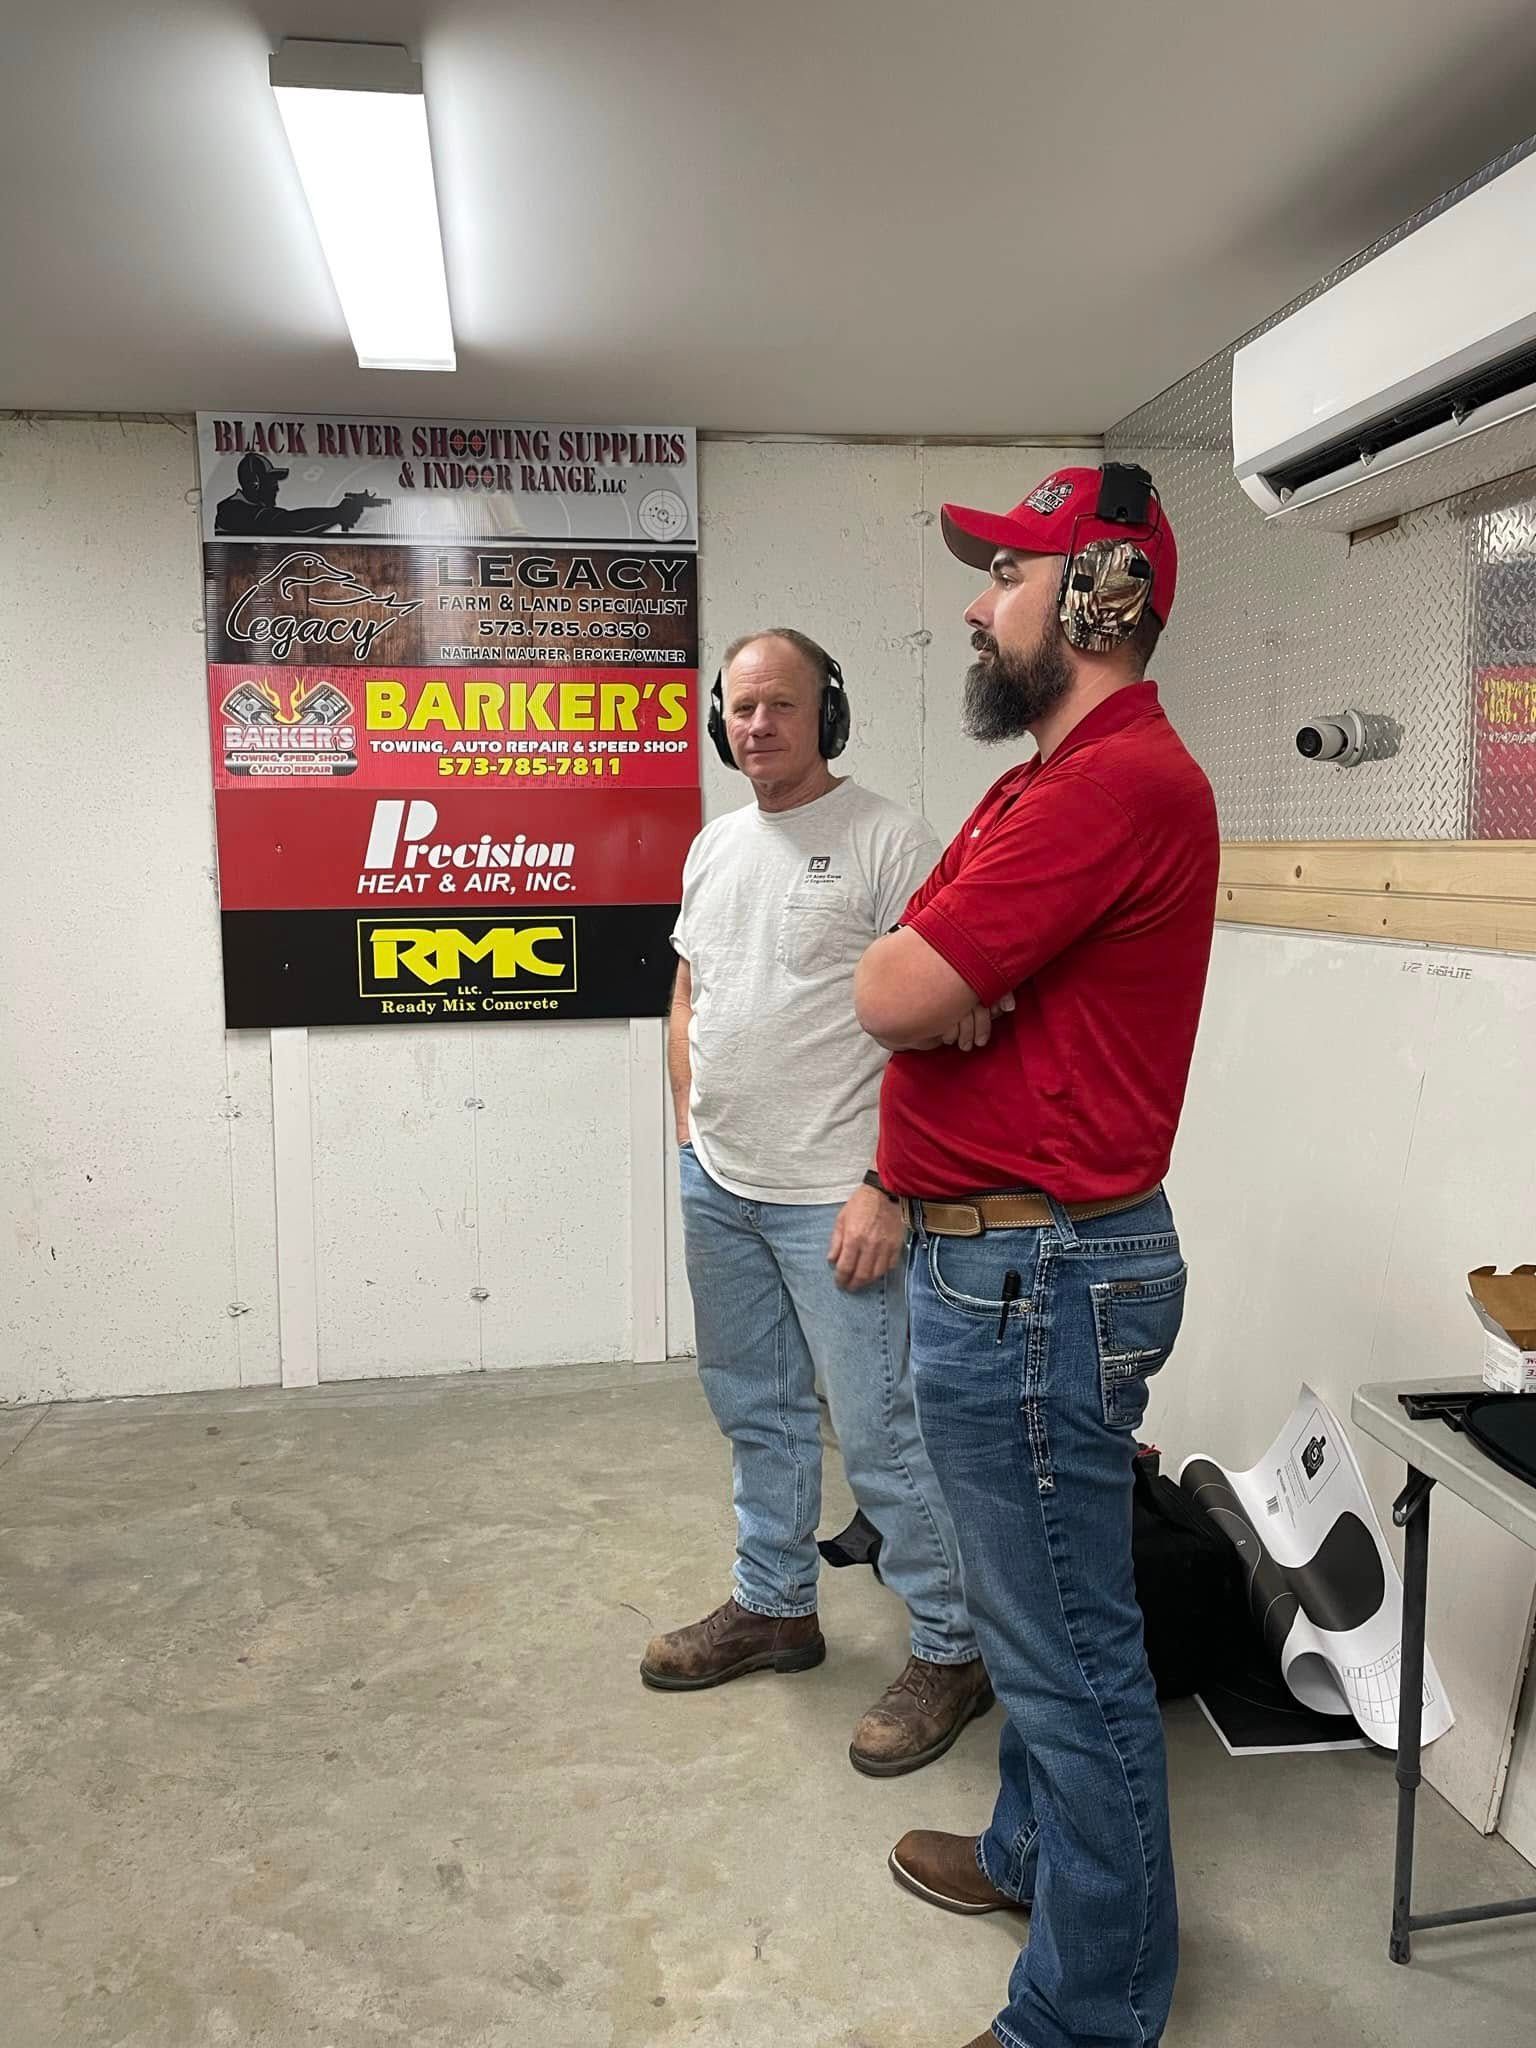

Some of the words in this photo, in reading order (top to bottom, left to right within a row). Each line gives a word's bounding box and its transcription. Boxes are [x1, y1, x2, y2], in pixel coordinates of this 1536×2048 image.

[213, 420, 307, 452] BLACK
[317, 423, 403, 457] RIVER
[412, 426, 550, 461] SHOOTING
[559, 430, 686, 464] SUPPLIES
[399, 462, 415, 488] &
[424, 462, 513, 490] INDOOR
[437, 555, 688, 592] LEGACY
[438, 595, 491, 611] FARM
[499, 595, 513, 611] &
[521, 596, 572, 612] LAND
[578, 598, 687, 616] SPECIALIST
[226, 585, 397, 660] Legacy
[478, 620, 651, 639] 573.785.0350
[440, 646, 501, 660] NATHAN
[506, 648, 570, 662] MAURER,
[574, 649, 686, 662] BROKER/OWNER
[365, 681, 688, 732] BARKER'S
[224, 726, 356, 751] BARKER'S
[370, 740, 449, 754] TOWING,
[452, 741, 502, 753] AUTO
[508, 741, 568, 753] REPAIR
[572, 741, 584, 753] &
[588, 741, 639, 753] SPEED
[643, 741, 689, 753] SHOP
[283, 753, 315, 763] SPEED
[318, 753, 347, 763] SHOP
[438, 757, 621, 776] 573-785-7811
[250, 765, 260, 775] &
[261, 765, 291, 775] AUTO
[294, 765, 332, 775] REPAIR
[364, 800, 576, 869] Precision
[357, 874, 431, 894] HEAT
[438, 873, 456, 893] &
[464, 873, 516, 895] AIR,
[525, 872, 577, 891] INC.
[369, 926, 566, 986] RMC
[458, 986, 482, 995] LLC.
[381, 1000, 436, 1015] Ready
[443, 999, 476, 1012] Mix
[482, 997, 559, 1011] Concrete
